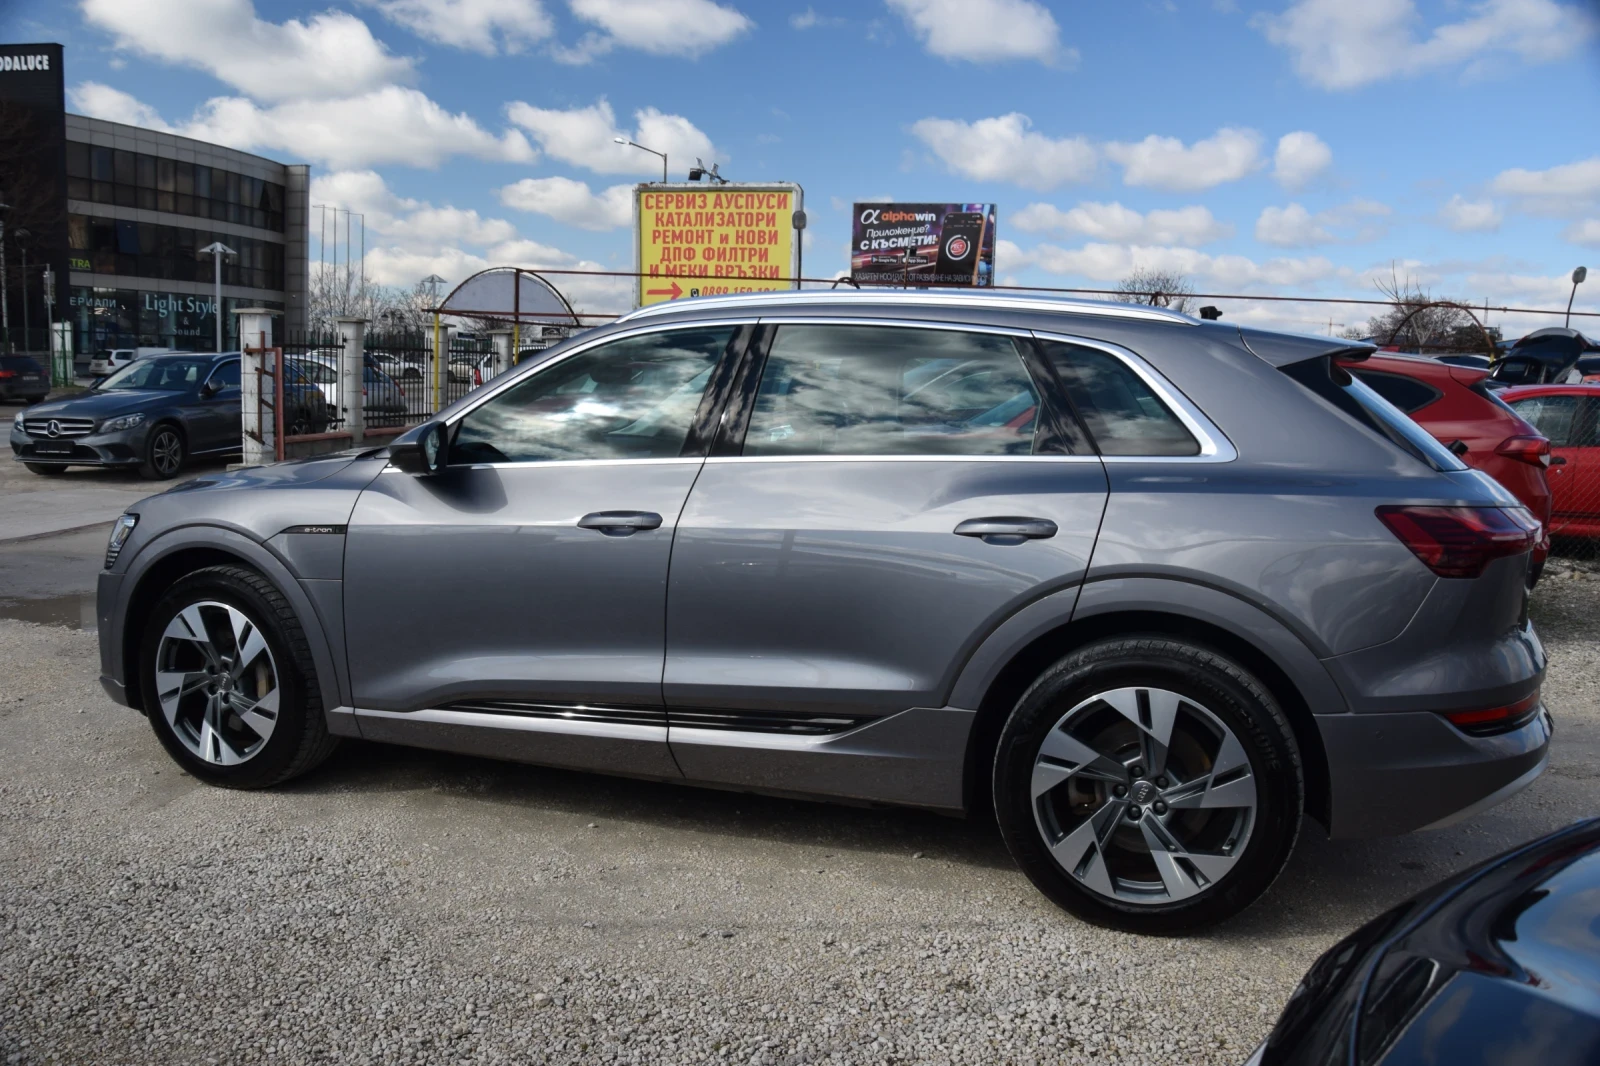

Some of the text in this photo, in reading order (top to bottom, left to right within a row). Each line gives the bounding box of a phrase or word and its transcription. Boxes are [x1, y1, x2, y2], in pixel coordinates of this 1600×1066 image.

[645, 193, 788, 209] СЕРВИЗ АУСПУСИ
[655, 212, 776, 227] КАТАЛИЗАТОРИ
[881, 211, 936, 223] alphawin
[652, 229, 714, 245] РЕМОНТ
[735, 230, 778, 245] НОВИ
[69, 258, 91, 268] TRA
[660, 247, 769, 264] ДПФ ФИЛТРИ
[649, 264, 780, 279] И МЕКИ ВРЪЗКИ
[145, 294, 218, 320] Light Style
[183, 317, 189, 325] &
[172, 327, 201, 336] Sound
